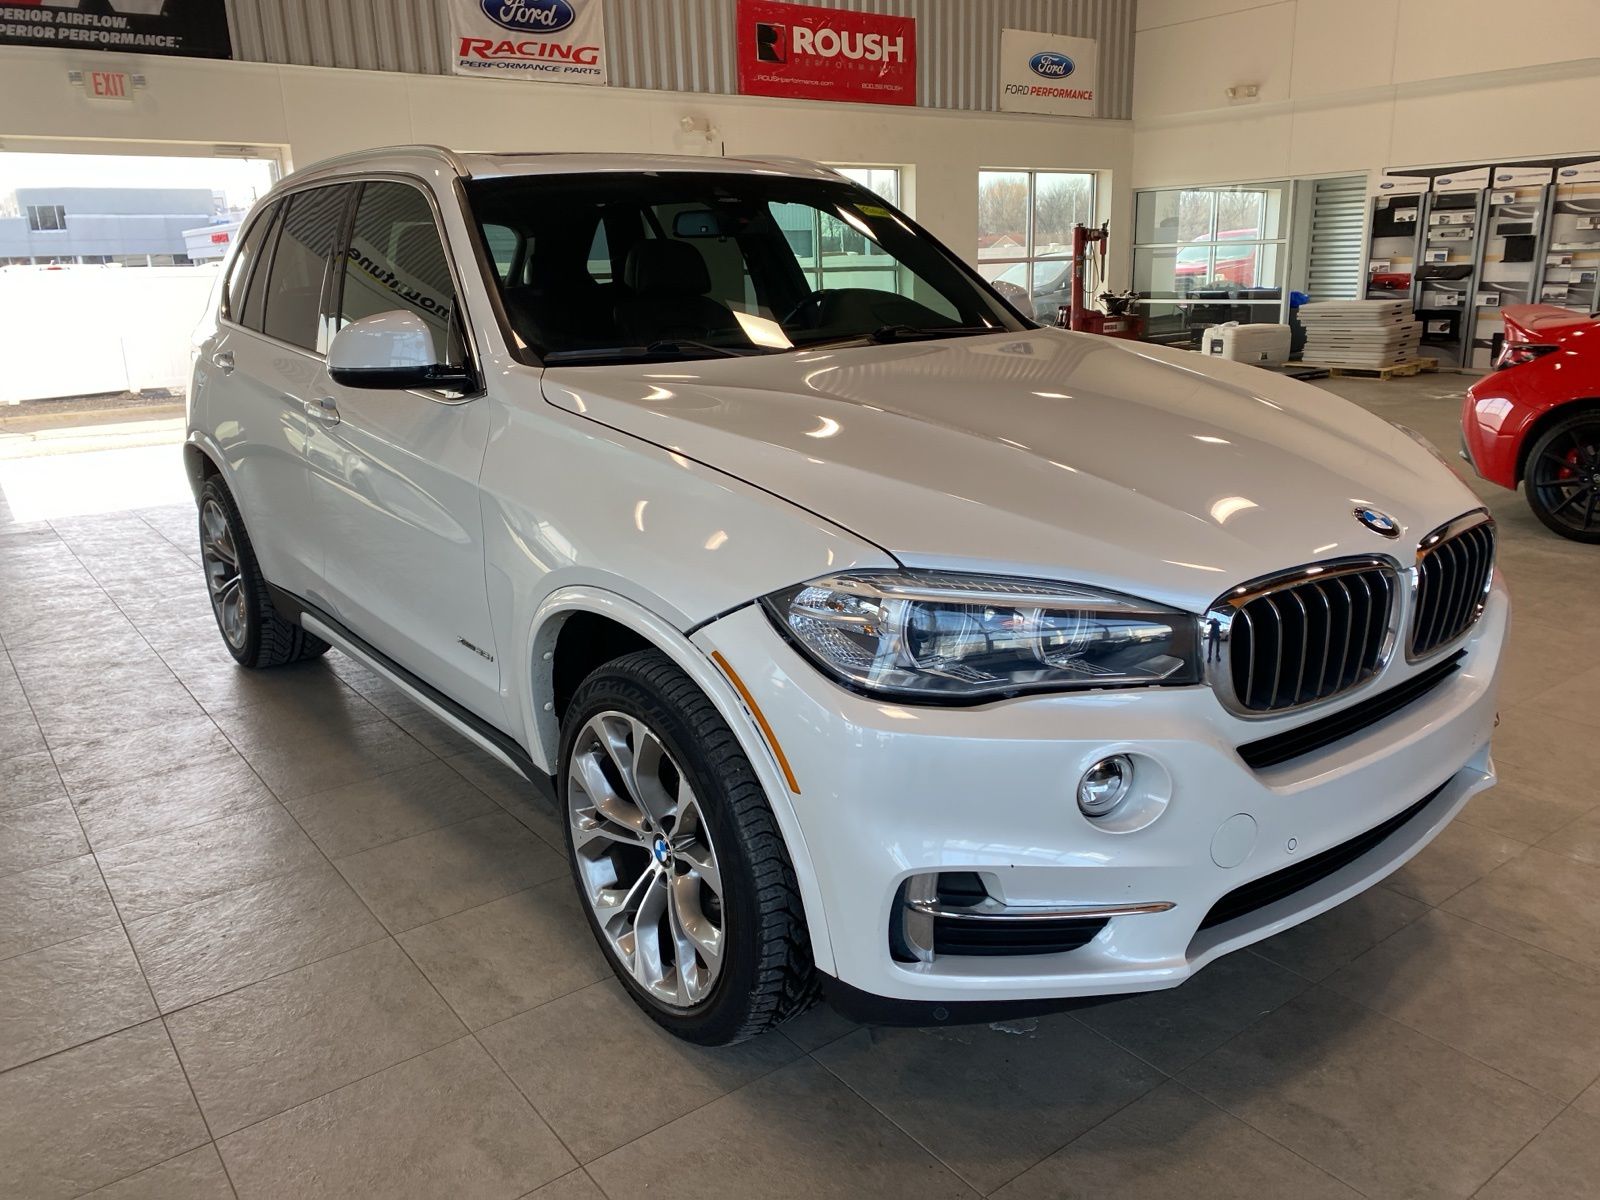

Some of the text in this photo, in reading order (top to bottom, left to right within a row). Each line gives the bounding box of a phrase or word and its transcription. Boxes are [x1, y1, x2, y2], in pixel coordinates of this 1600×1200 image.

[55, 11, 131, 29] AIRFLOW.
[500, 0, 557, 26] Ford
[459, 37, 599, 65] RACING
[793, 26, 903, 62] ROUSH
[460, 60, 601, 75] PERFORMANCE PARTS
[1038, 55, 1066, 74] Ford
[92, 72, 125, 96] EXIT
[1005, 84, 1093, 100] FORD PERFORMANCE
